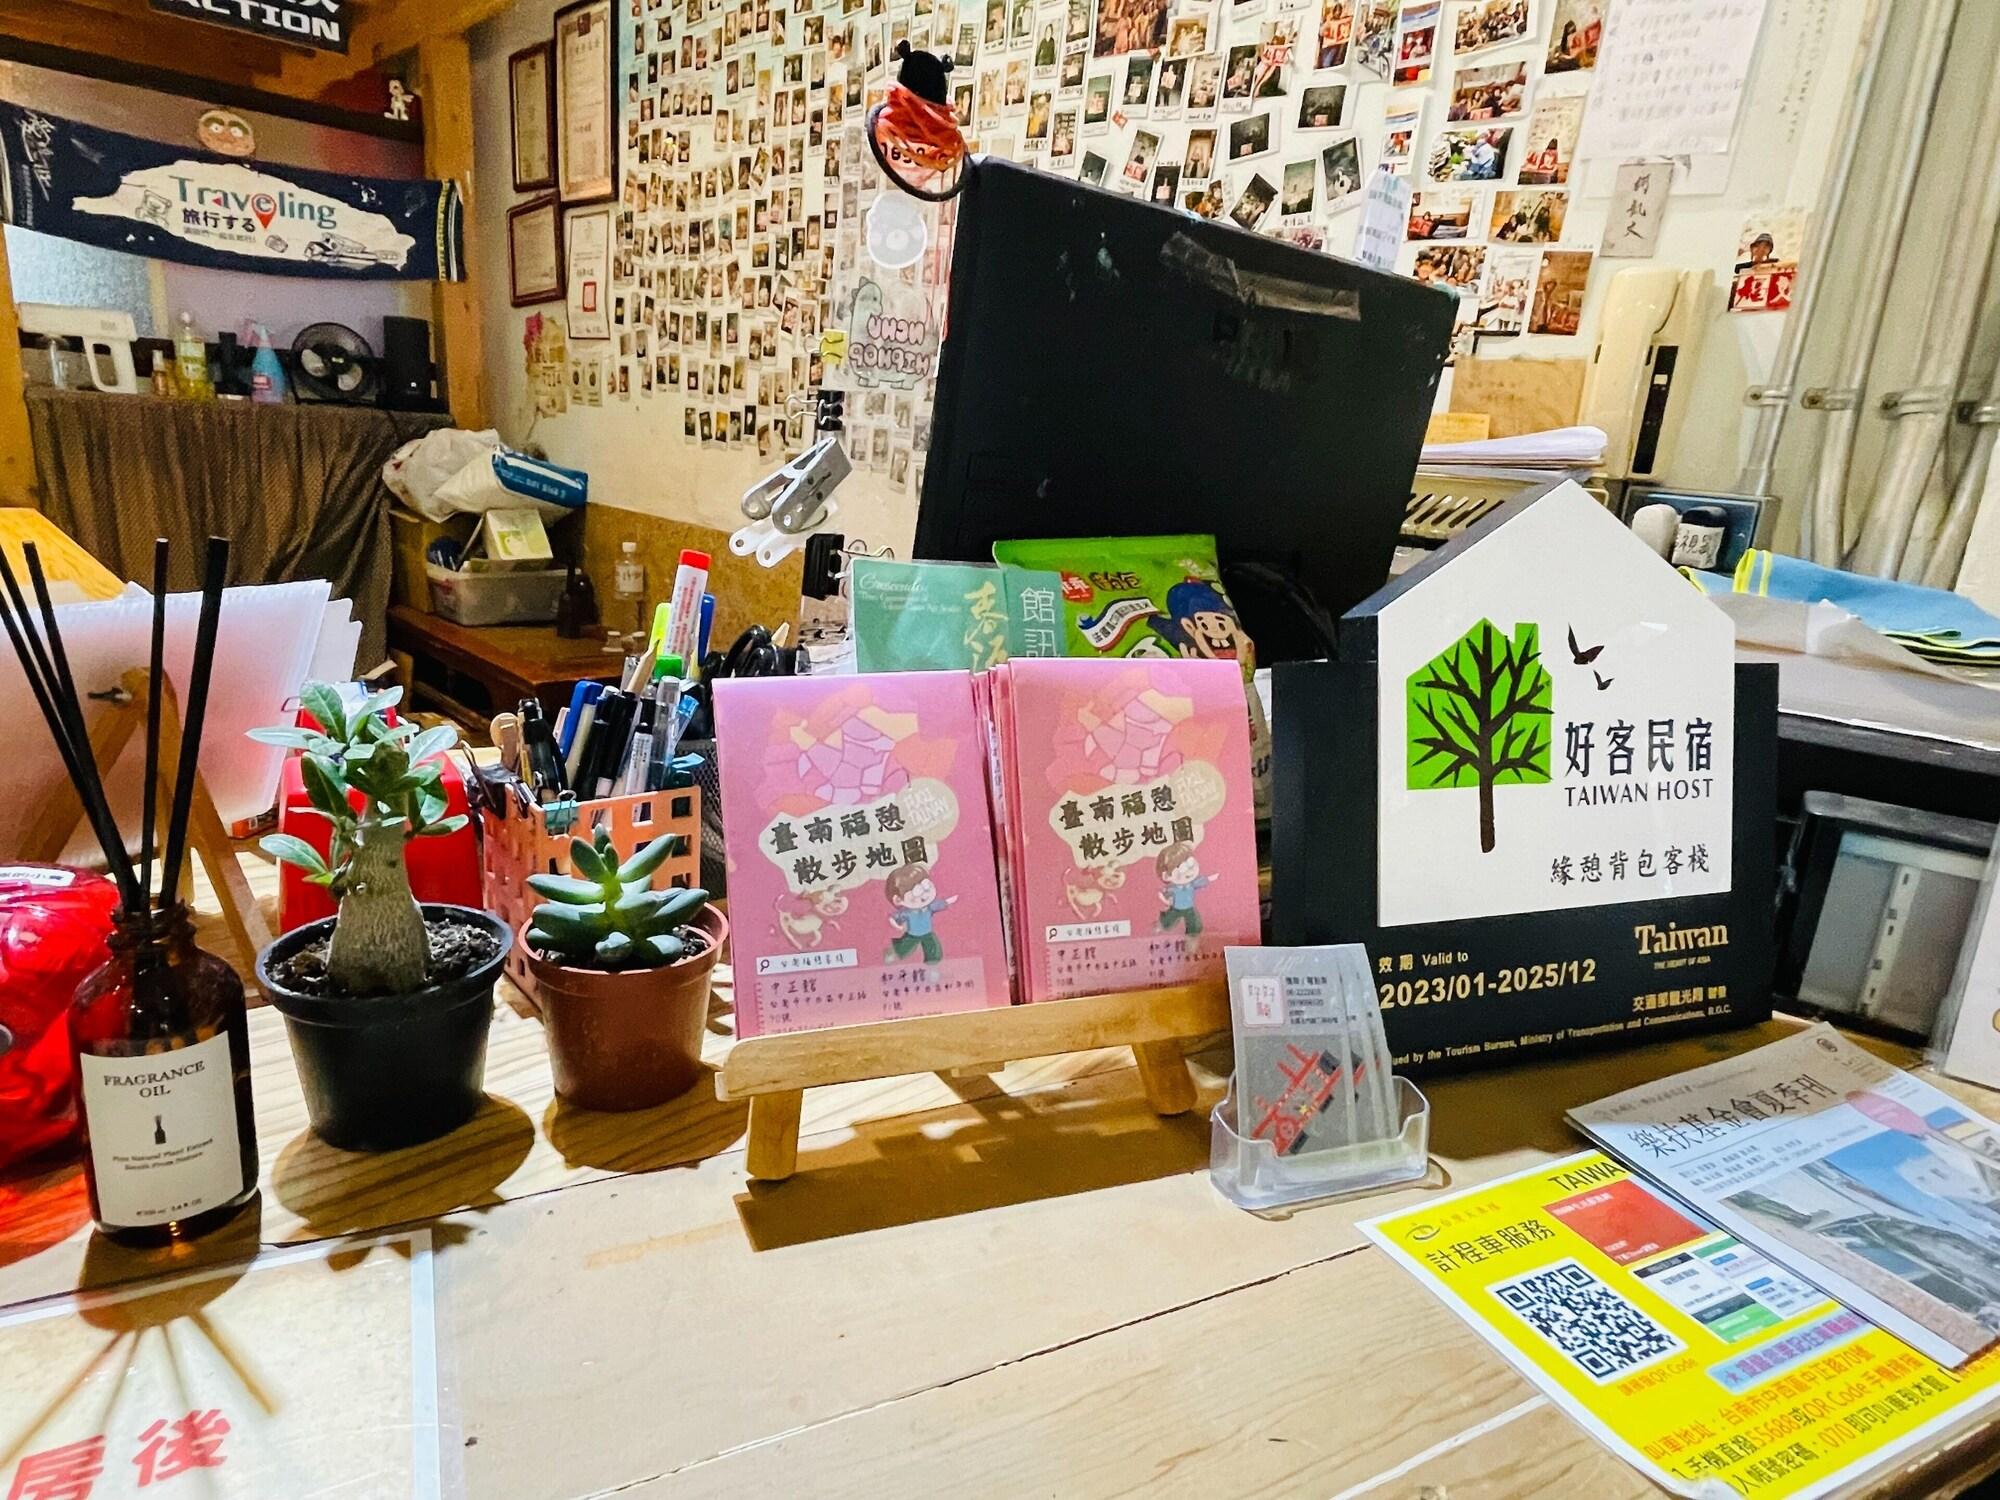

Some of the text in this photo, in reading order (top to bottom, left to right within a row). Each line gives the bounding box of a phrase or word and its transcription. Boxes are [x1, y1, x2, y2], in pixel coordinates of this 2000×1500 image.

[169, 175, 337, 230] Traveling
[183, 208, 256, 233] 旅行する
[1564, 717, 1713, 778] 好客民宿
[1059, 784, 1177, 830] 臺南福憩
[1564, 778, 1714, 807] TAIWAN HOST
[770, 803, 906, 854] 臺南福憩
[1080, 816, 1195, 861] 散步地圖
[793, 836, 928, 885] 散步地圖
[1550, 844, 1710, 885] 緣憩背包客棧
[1422, 952, 1453, 967] Valid
[1457, 951, 1469, 964] to
[1635, 922, 1729, 955] Taiwan
[1380, 958, 1596, 1009] 2023/01-2025/12
[103, 1061, 206, 1087] FRAGRANCE
[1392, 1056, 1409, 1066] ued
[1413, 1053, 1424, 1064] by
[1427, 1050, 1442, 1061] the
[1446, 1044, 1481, 1056] Tourism
[139, 1085, 171, 1098] OIL
[1425, 1218, 1557, 1273] 計程車服務
[1826, 1381, 1872, 1407] Code
